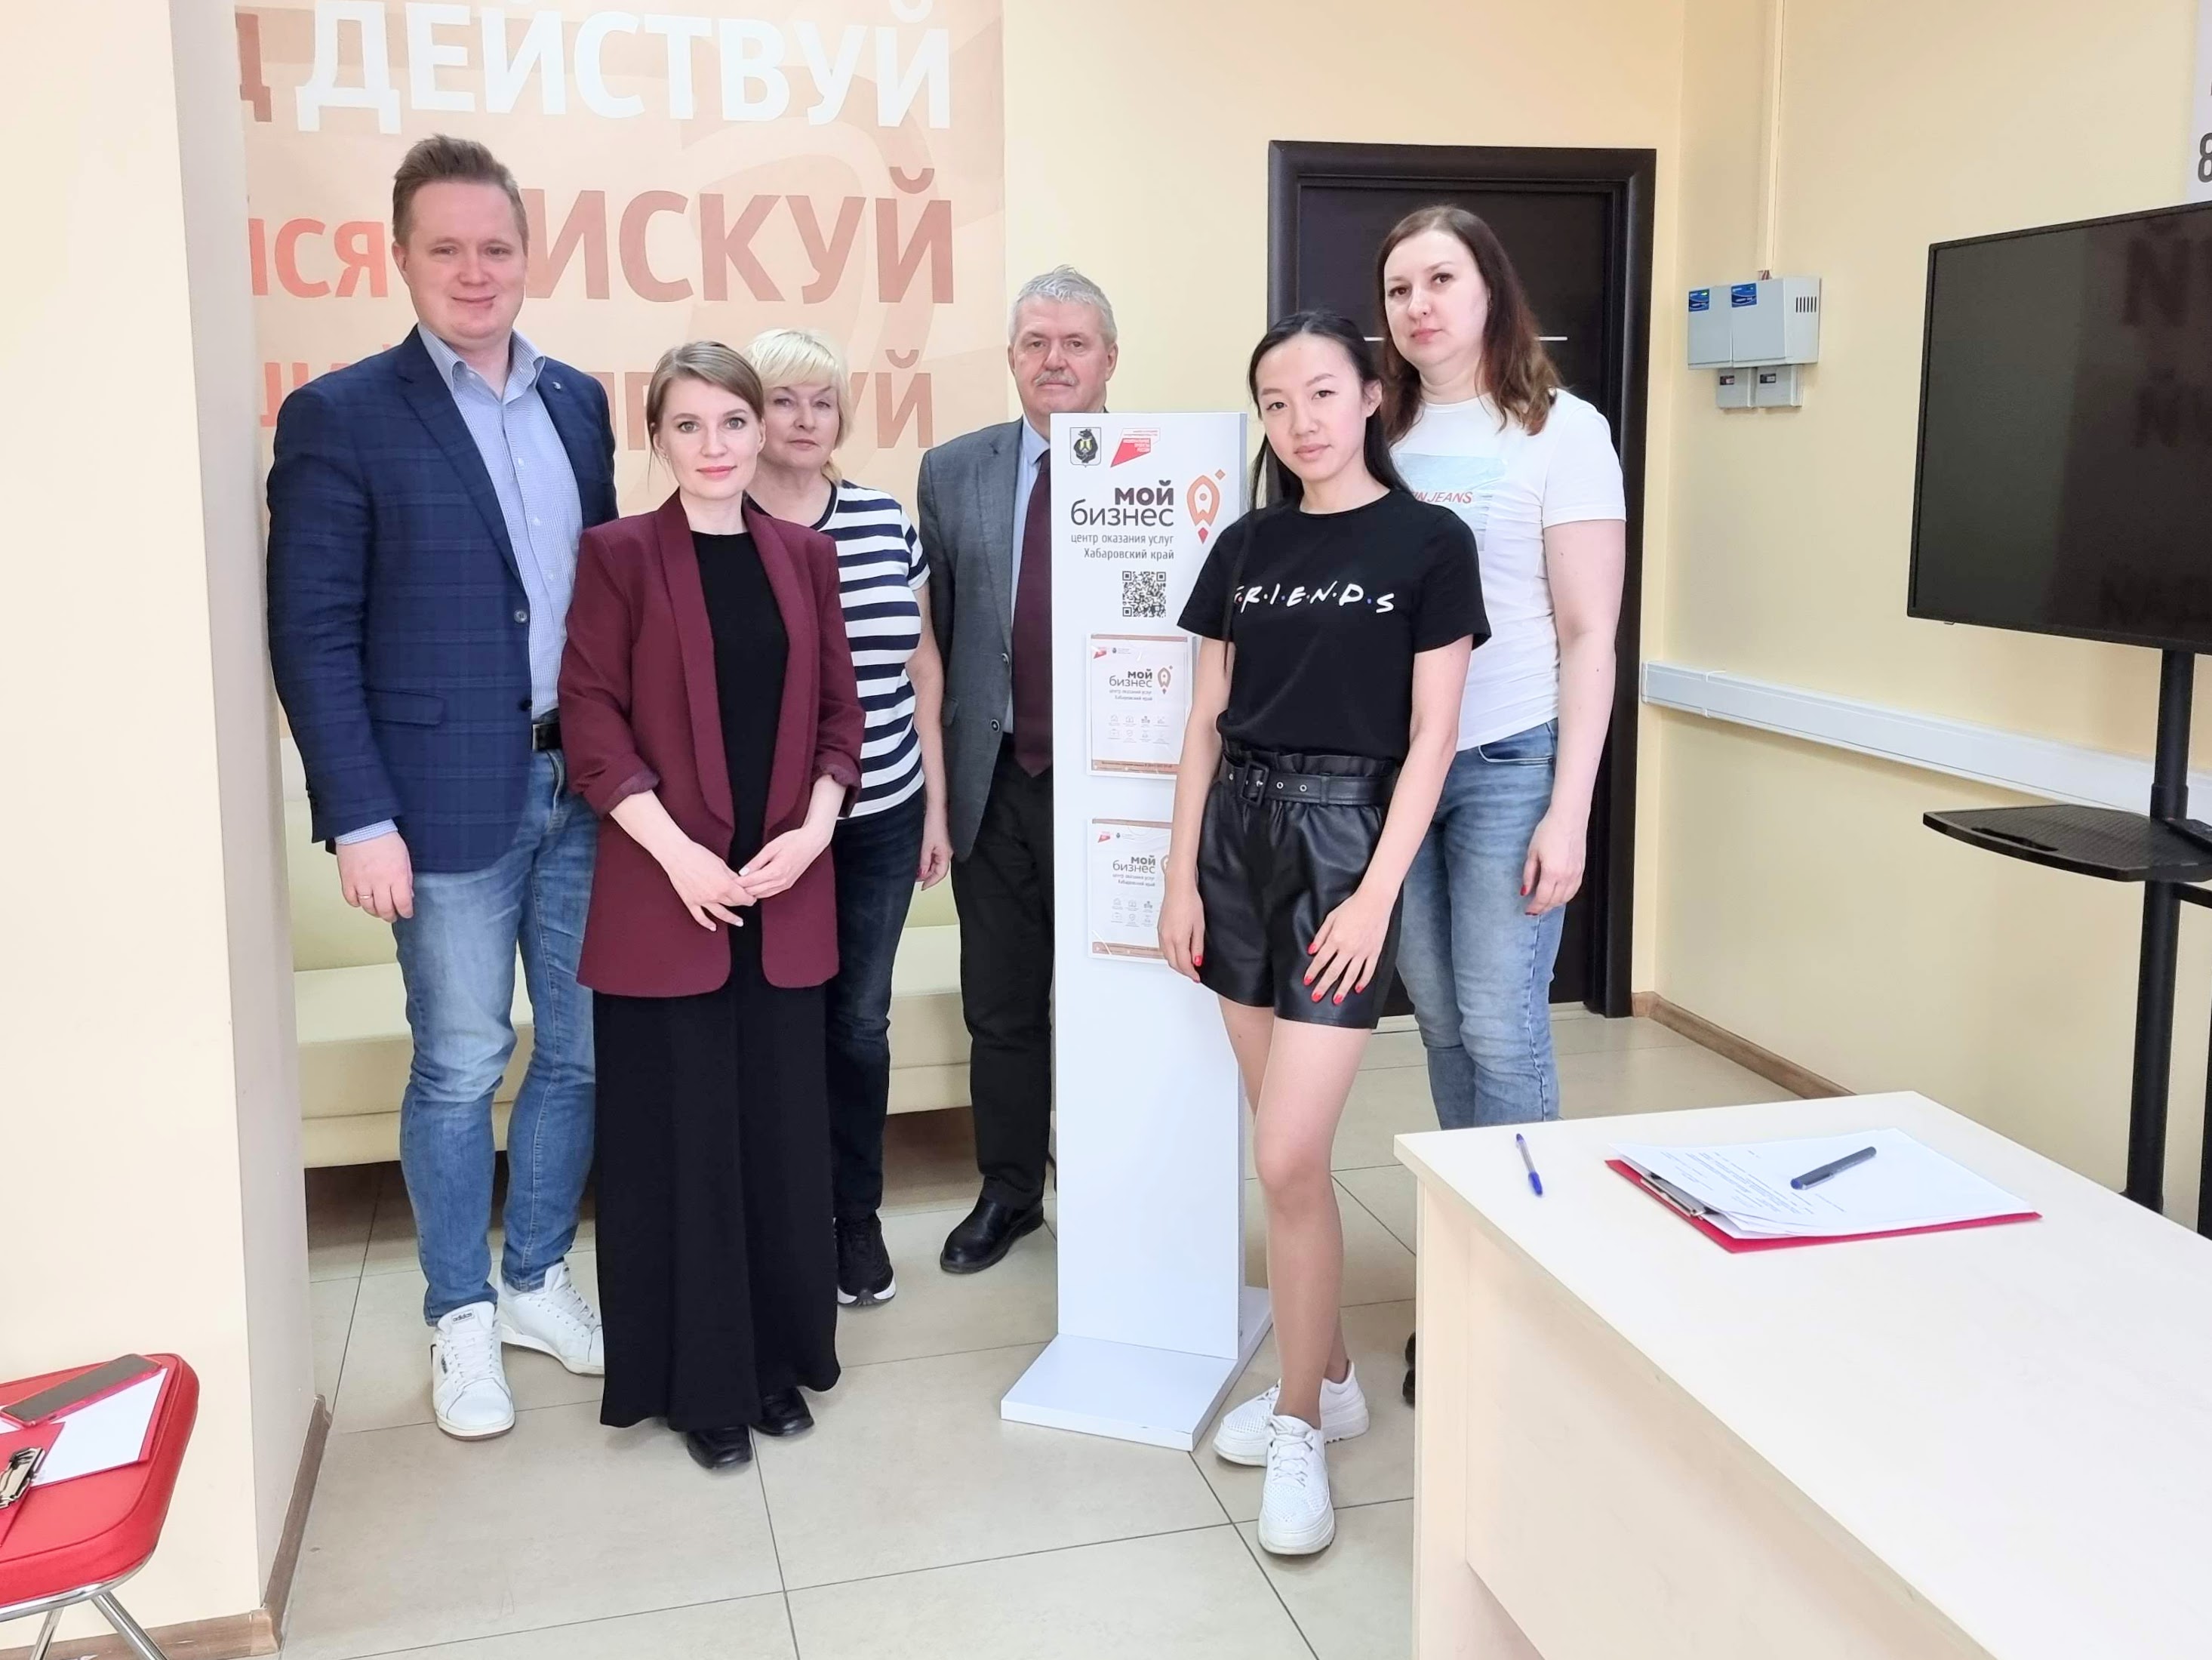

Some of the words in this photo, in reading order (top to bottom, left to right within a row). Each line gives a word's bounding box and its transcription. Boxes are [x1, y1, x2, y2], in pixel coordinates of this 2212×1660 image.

[295, 0, 950, 134] ДЕЙСТВУЙ
[520, 166, 953, 303] ИСКУЙ
[1427, 491, 1473, 504] JEANS
[1071, 498, 1174, 527] бизнес
[1071, 534, 1098, 545] центр
[1102, 534, 1146, 544] оказания
[1148, 535, 1174, 547] услуг
[1084, 547, 1147, 560] Хабаровский
[1150, 550, 1174, 561] край
[1109, 675, 1152, 688] бизнес
[1112, 859, 1155, 874] бизнес
